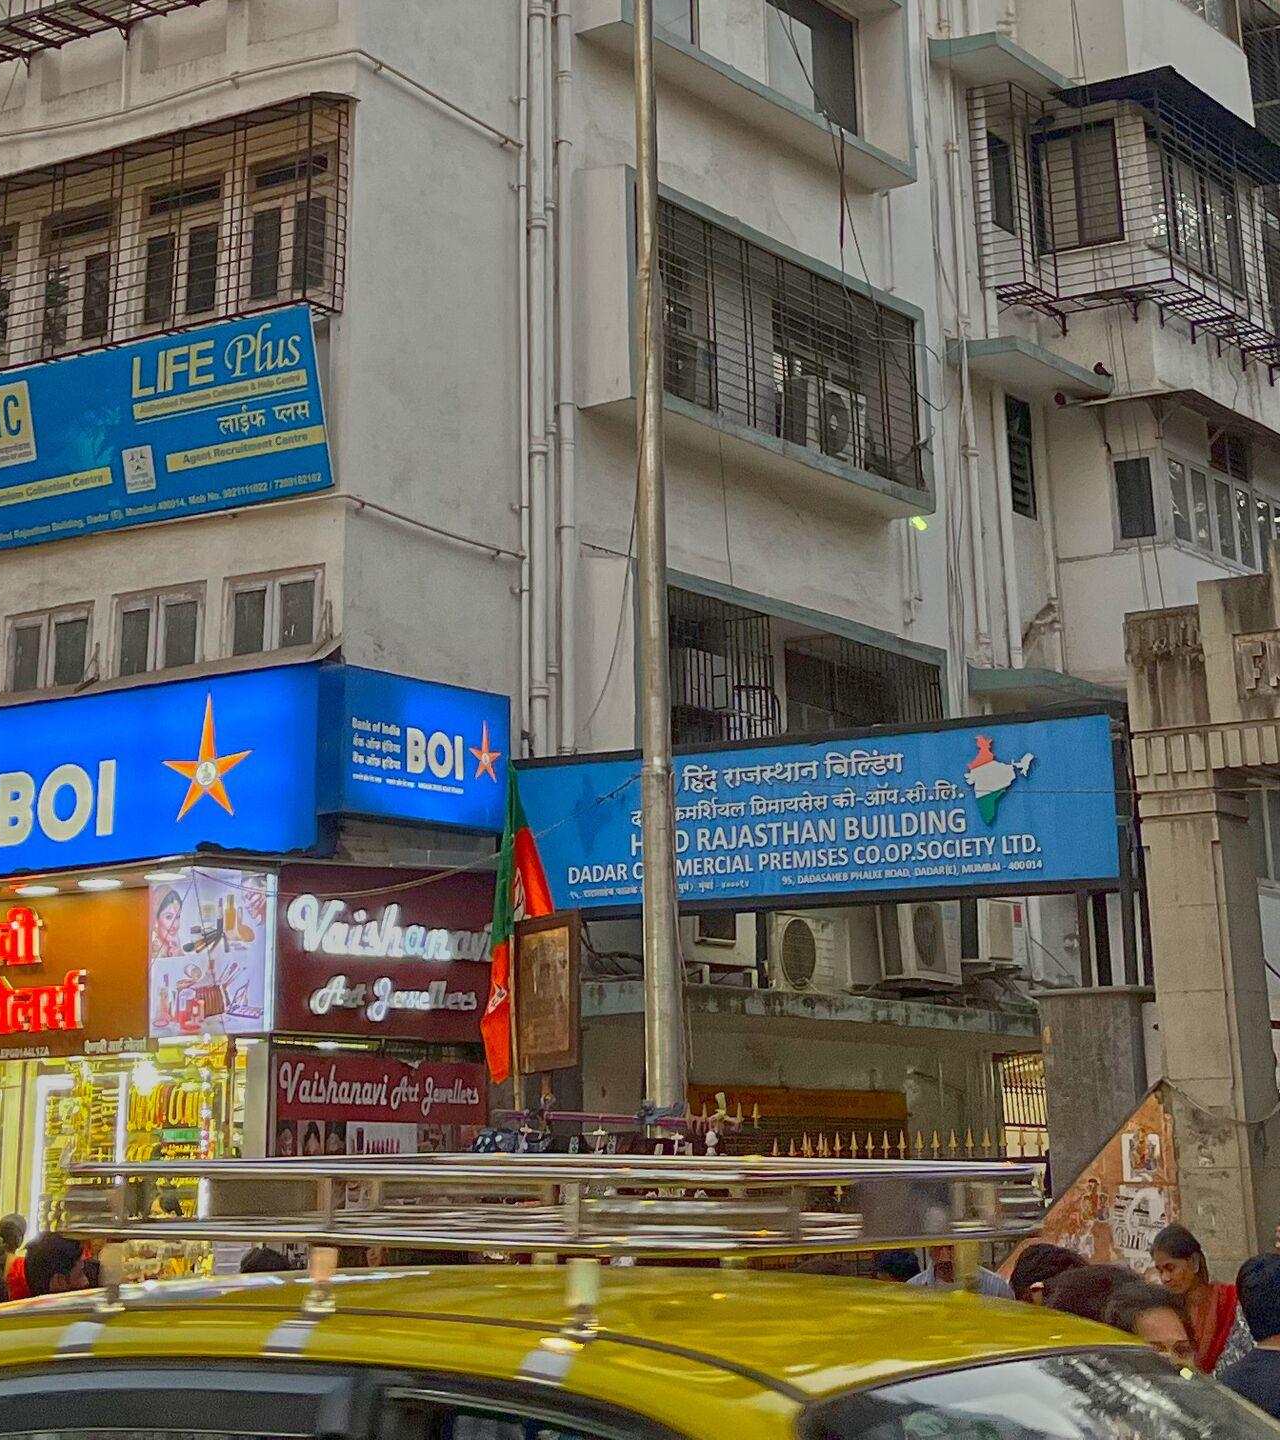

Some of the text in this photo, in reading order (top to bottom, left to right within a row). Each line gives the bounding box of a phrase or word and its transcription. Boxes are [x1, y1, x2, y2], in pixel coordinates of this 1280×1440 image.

[131, 322, 302, 398] LIFE Plus
[217, 401, 310, 435] लाईफ प्लस
[183, 433, 308, 465] Agent Recruitment Centre
[406, 727, 464, 781] BOI
[682, 749, 904, 792] हिंद राजस्थान बिल्डिंग
[631, 808, 966, 857] HD RAJASTHAN BUILDING
[568, 834, 1042, 885] DADAR CMERCIAL PREMISES CO.OP.SOCIETY LTD.
[782, 876, 795, 886] 95,
[798, 872, 848, 885] DADASAHEB
[850, 869, 883, 881] PHALKE
[885, 868, 912, 879] ROAD,
[962, 863, 1001, 874] MUMBAI
[310, 975, 477, 1021] Art Jewellers
[279, 1062, 479, 1115] Vaishanavi Art Jewellers
